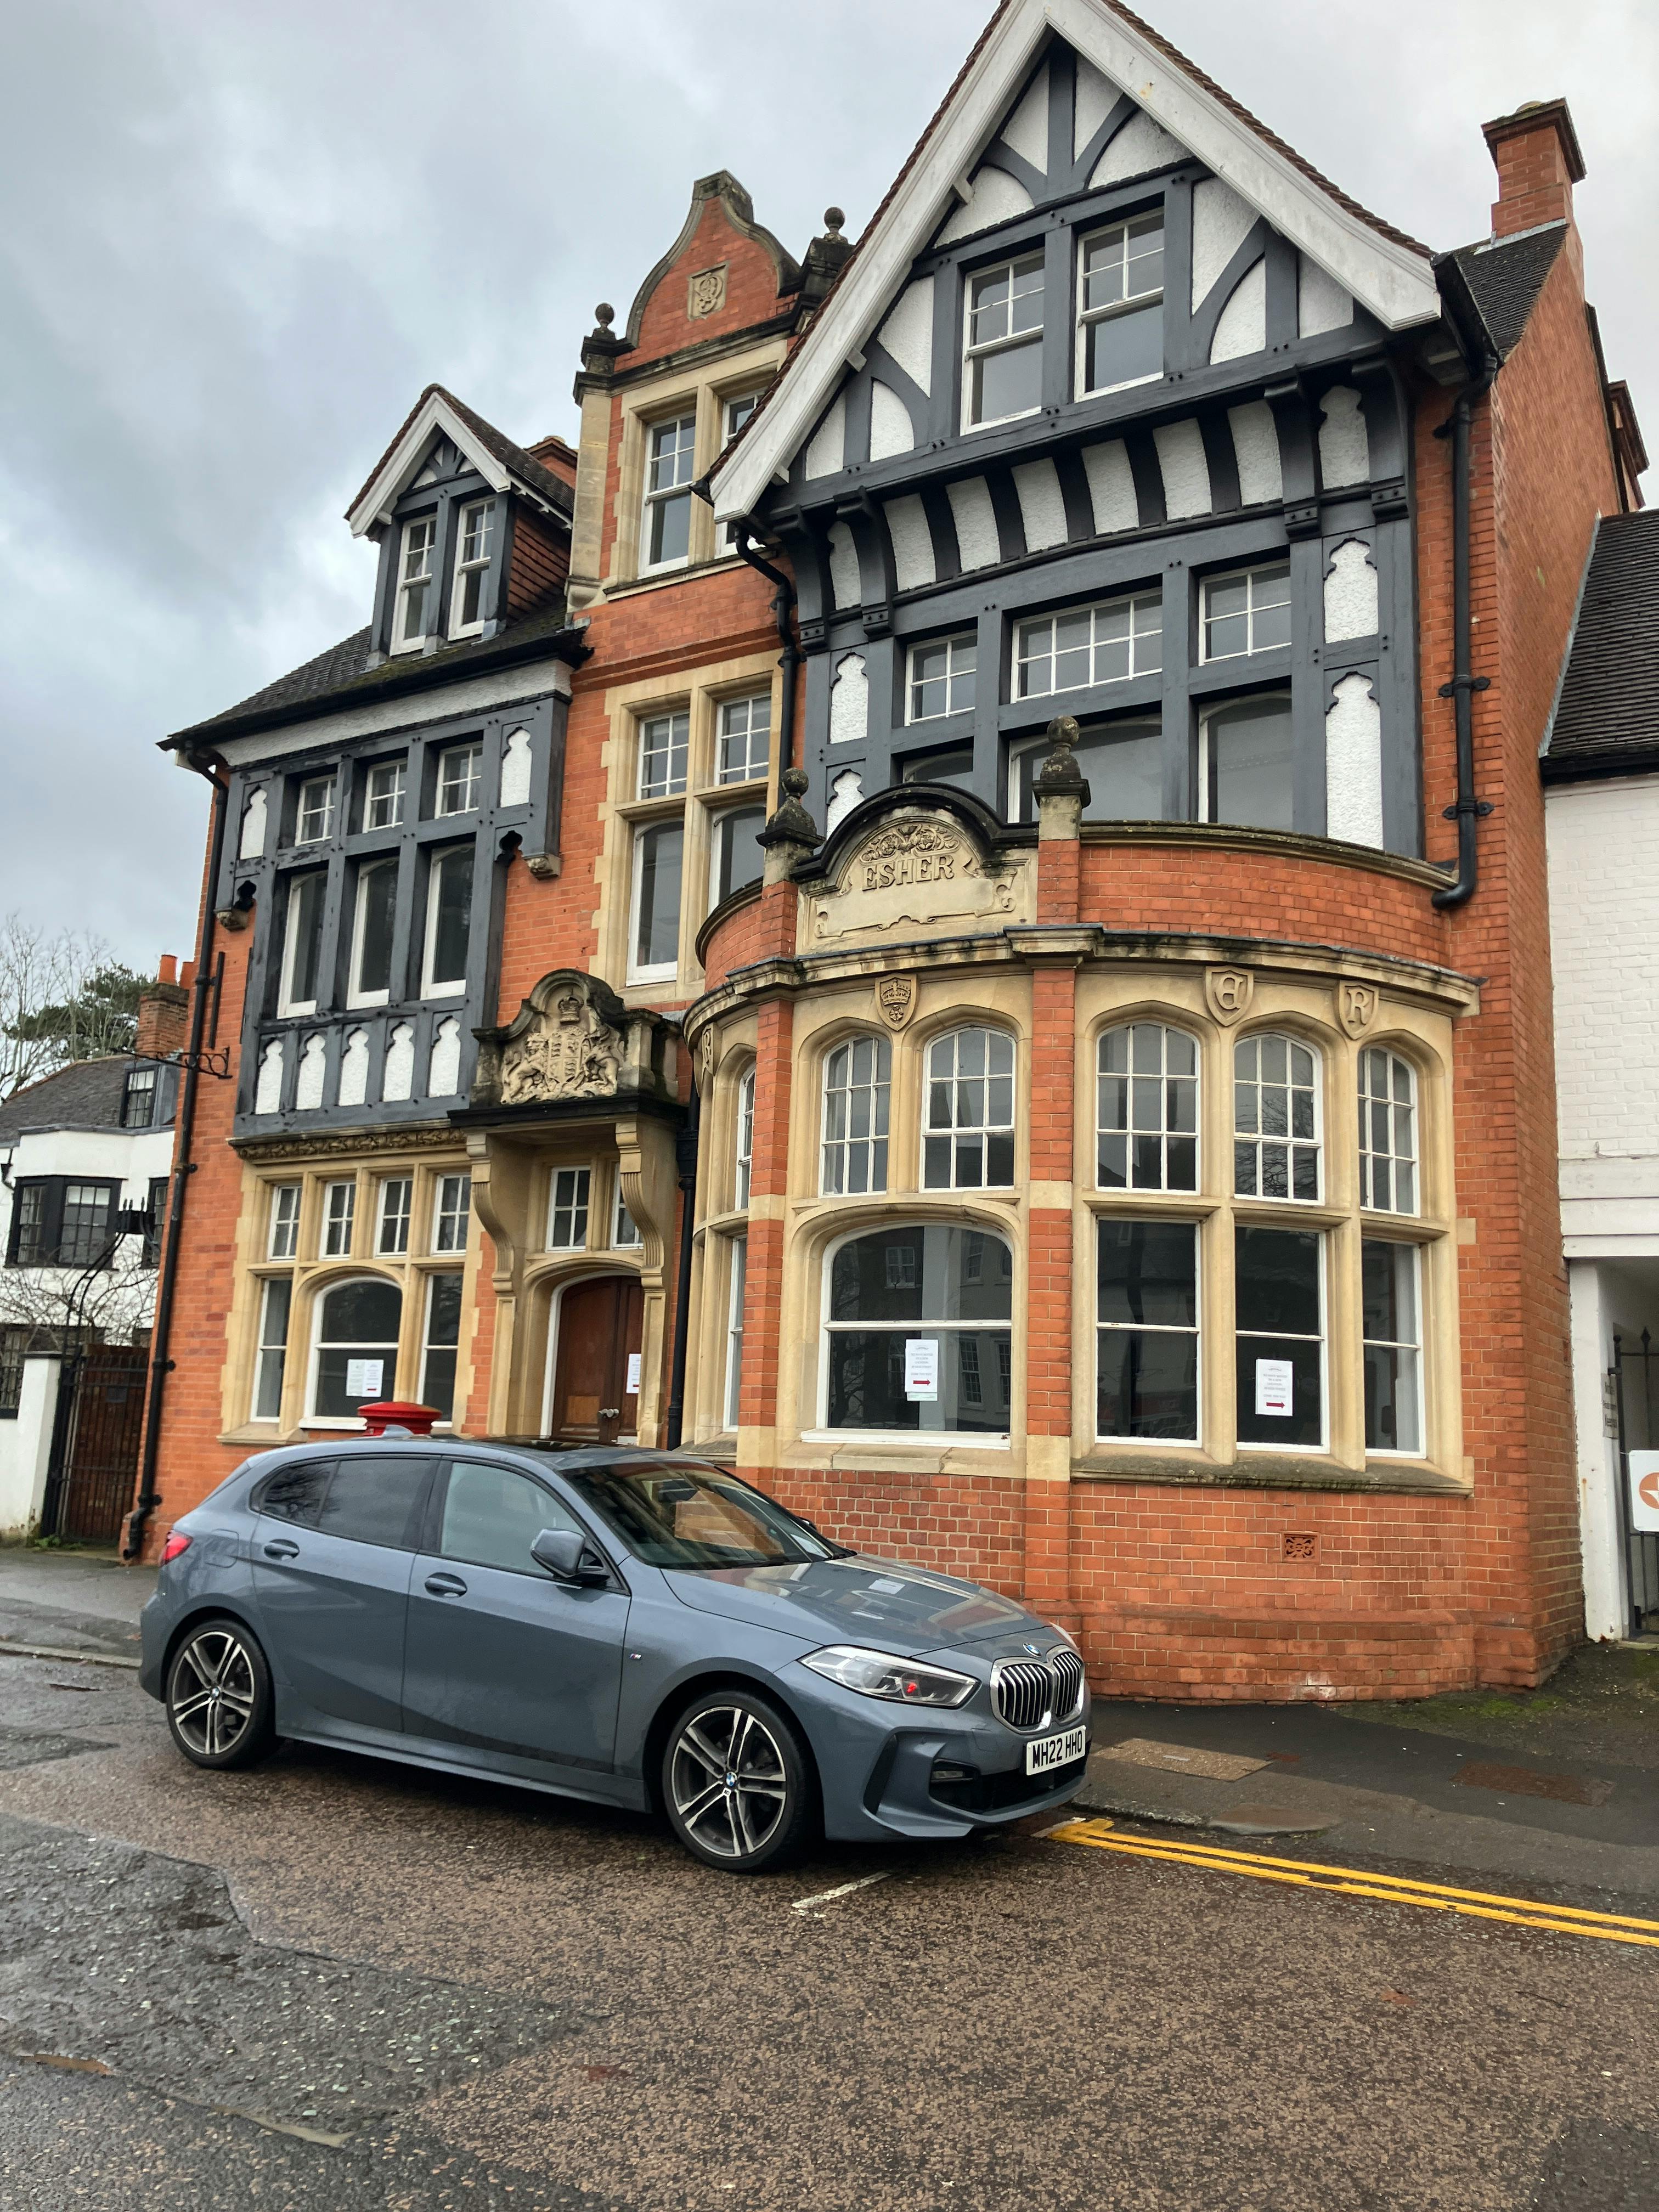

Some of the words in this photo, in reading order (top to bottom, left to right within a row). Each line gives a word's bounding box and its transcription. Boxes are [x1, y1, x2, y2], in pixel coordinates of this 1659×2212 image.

[862, 854, 955, 891] ESHER
[1346, 988, 1372, 1025] R
[1032, 1737, 1063, 1769] MH22
[1065, 1730, 1082, 1758] HHO
